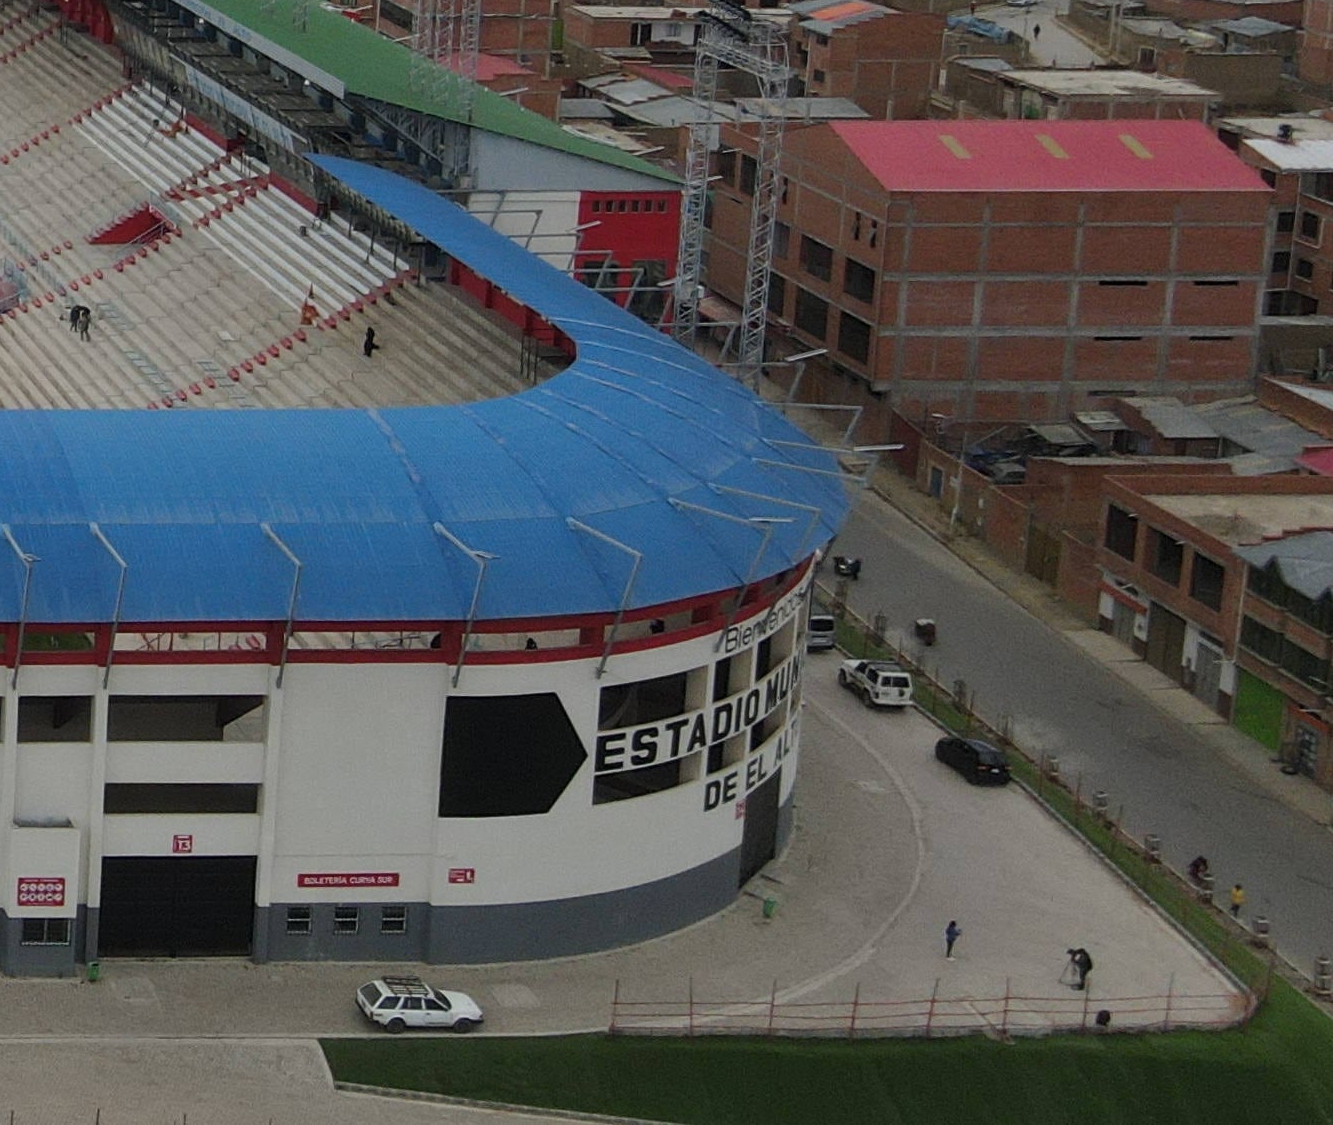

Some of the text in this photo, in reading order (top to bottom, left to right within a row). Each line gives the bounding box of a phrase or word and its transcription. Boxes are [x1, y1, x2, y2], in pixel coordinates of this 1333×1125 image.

[595, 689, 760, 772] ESTADIO
[704, 771, 738, 812] DE
[746, 754, 767, 790] EL
